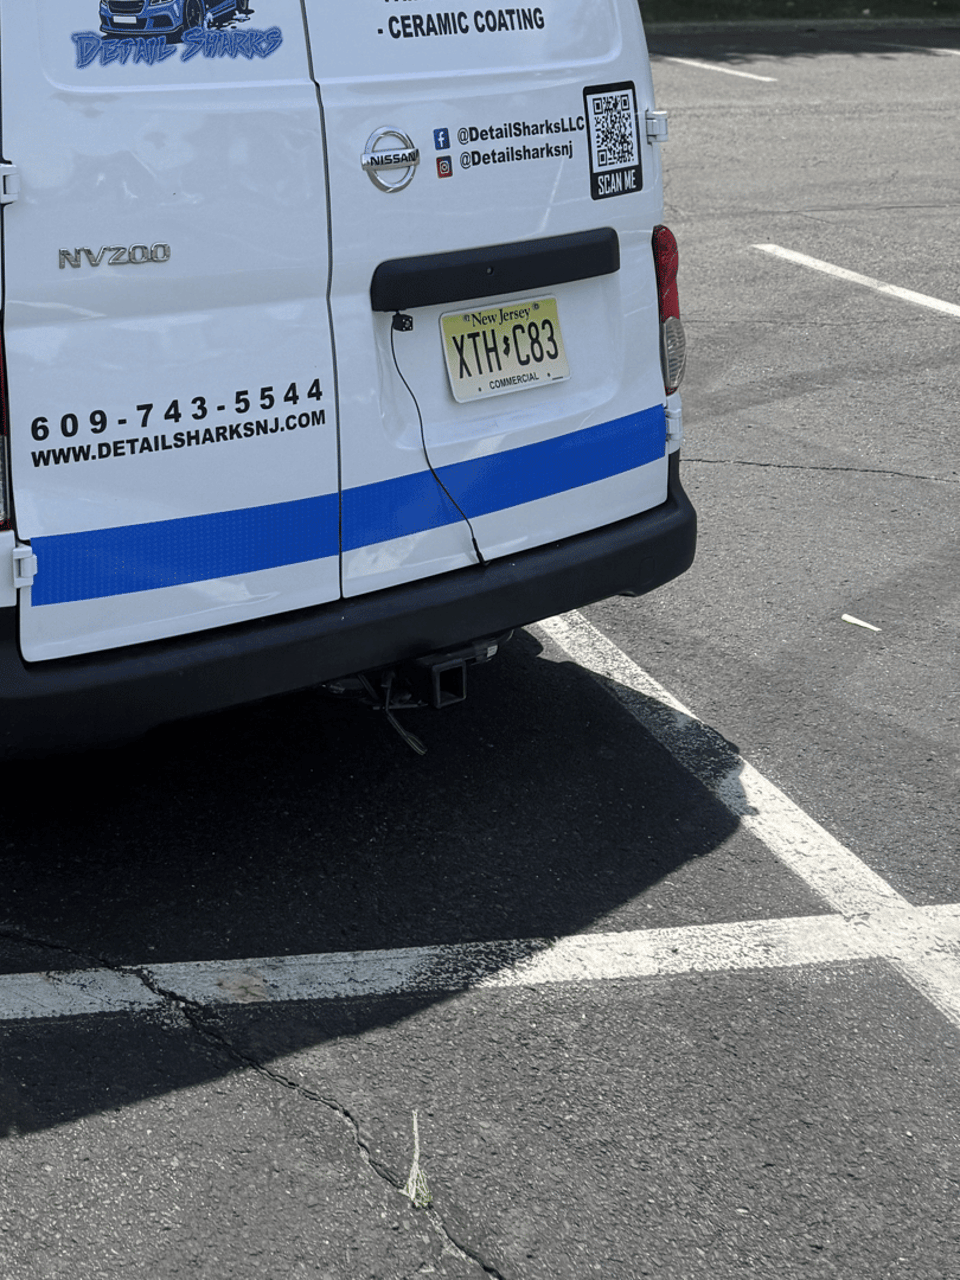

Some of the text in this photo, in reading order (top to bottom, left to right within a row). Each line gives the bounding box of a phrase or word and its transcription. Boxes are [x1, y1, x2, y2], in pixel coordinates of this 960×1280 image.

[387, 7, 546, 39] CERAMIC COATING
[457, 116, 585, 145] @DetailSharksLLC
[370, 152, 416, 166] NISSAN
[460, 140, 574, 169] @Detailsharksnj
[597, 169, 637, 195] SCAN ME
[58, 241, 172, 269] NV200
[471, 308, 530, 327] New Jersey
[489, 372, 539, 390] COMMERCIAL
[31, 378, 323, 440] 609-743-5544
[31, 409, 326, 468] WWW.DETAILSHARKSNJ.COM
